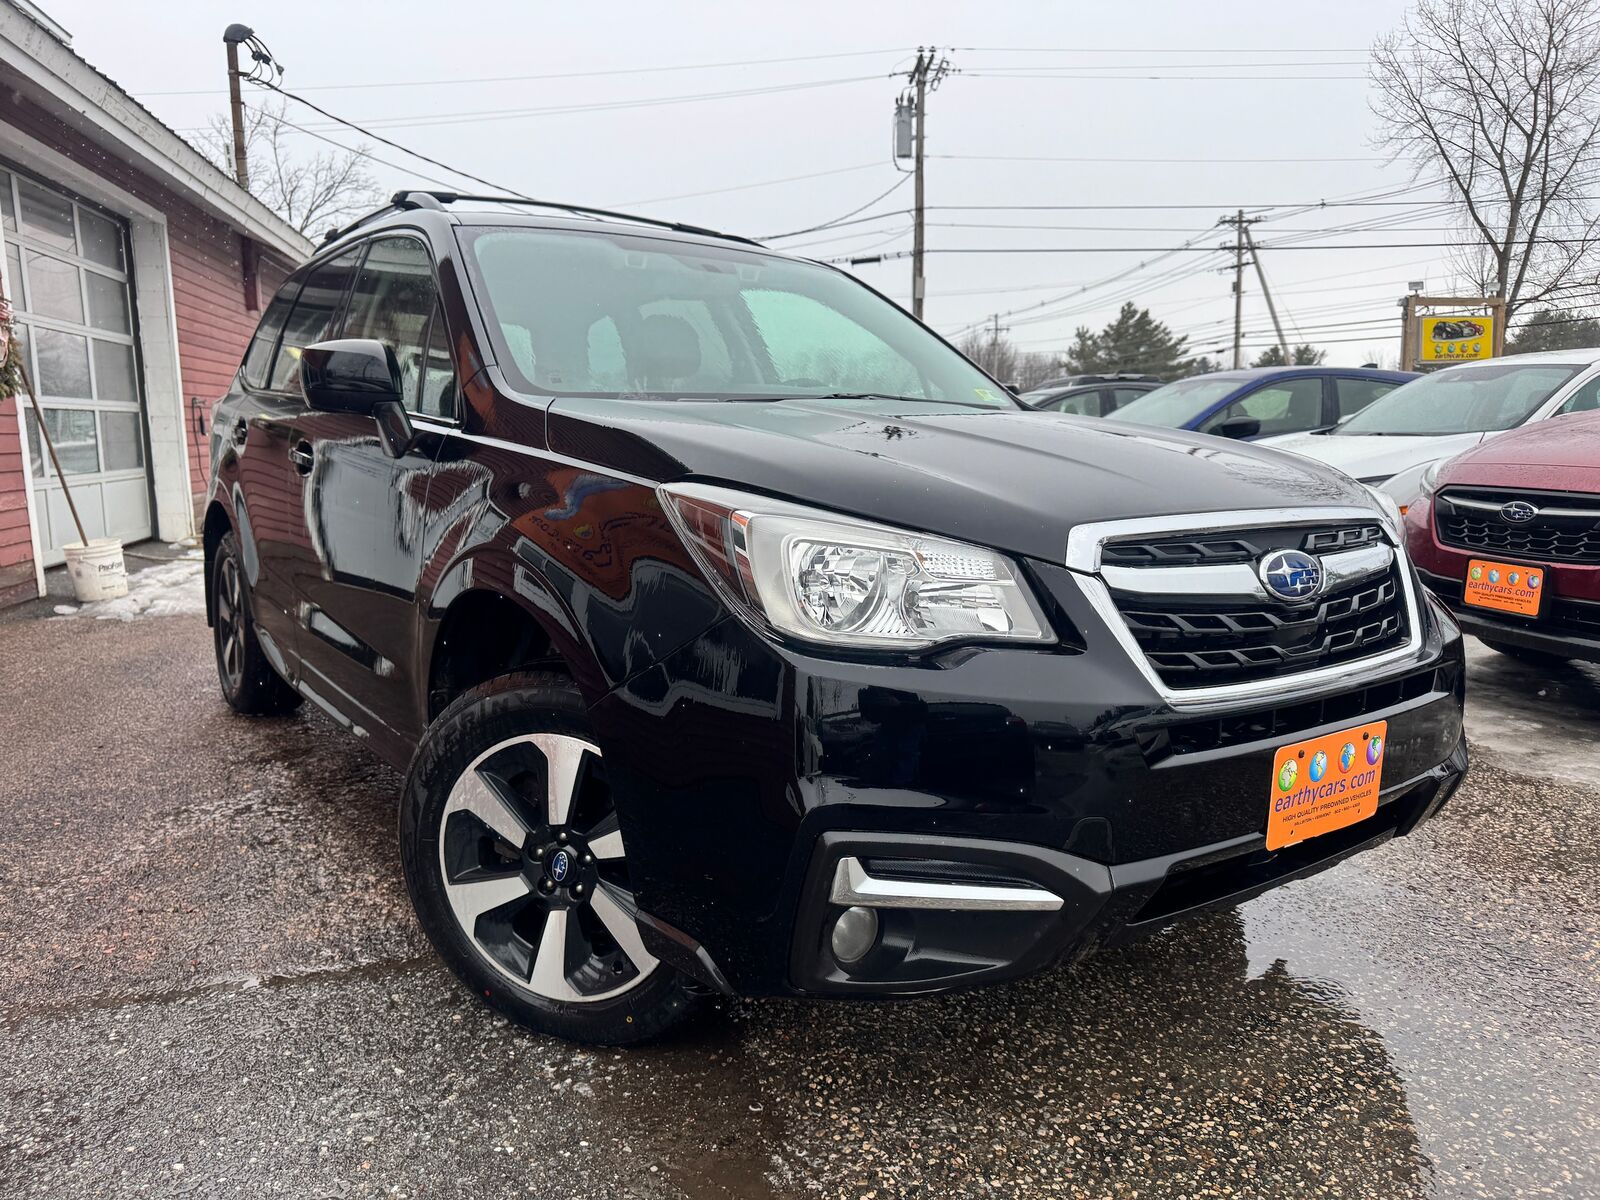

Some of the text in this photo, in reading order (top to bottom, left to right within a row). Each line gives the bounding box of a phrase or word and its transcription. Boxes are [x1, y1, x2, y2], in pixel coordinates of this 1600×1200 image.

[1468, 580, 1535, 598] earthycars.com
[1275, 769, 1376, 813] earthycars.com
[1282, 813, 1297, 823] HIGH
[1296, 806, 1319, 819] QUALITY
[1319, 797, 1350, 812] PREOWNED
[1349, 789, 1372, 802] VEHICLES
